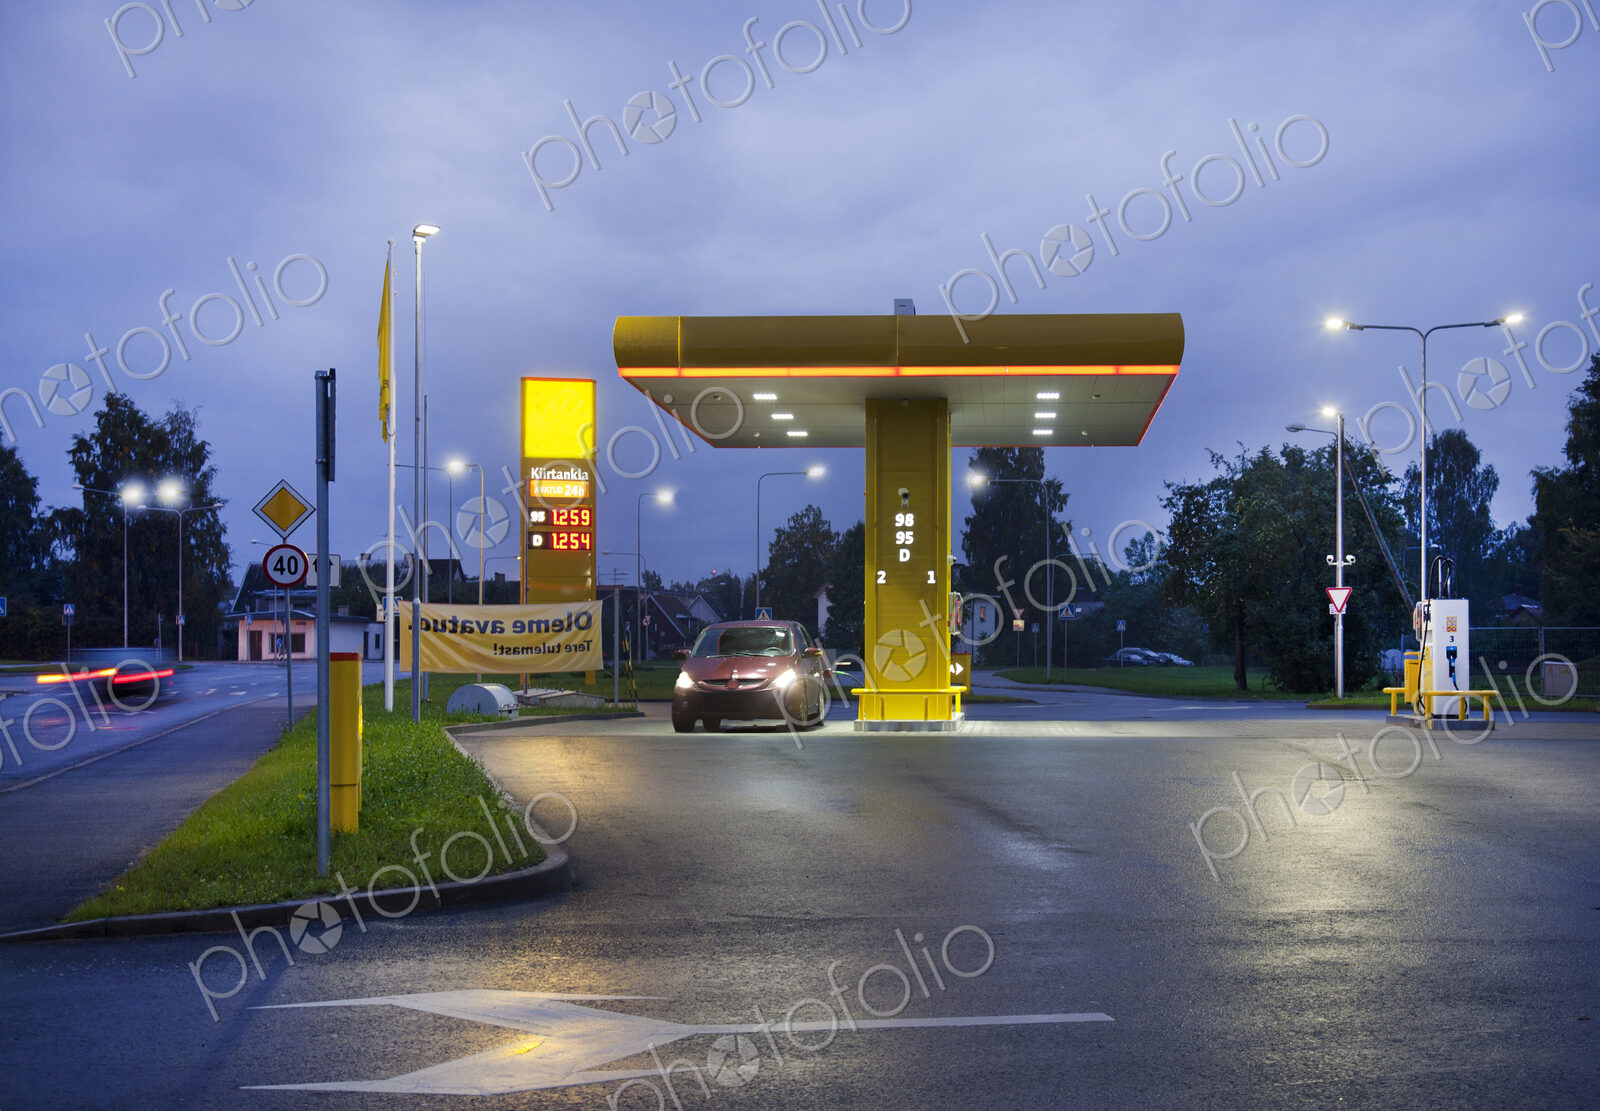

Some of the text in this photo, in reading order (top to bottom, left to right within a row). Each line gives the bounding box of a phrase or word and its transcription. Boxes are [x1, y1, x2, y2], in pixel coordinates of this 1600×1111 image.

[531, 467, 589, 480] Kiirtankla
[564, 485, 585, 497] 24h
[552, 509, 590, 526] 1.259
[895, 513, 914, 527] 98
[532, 533, 590, 550] D 1.254
[895, 531, 914, 545] 95
[899, 548, 911, 562] D
[273, 555, 299, 575] 40
[877, 570, 887, 584] 2
[927, 570, 936, 584] 1
[1449, 635, 1455, 643] 3
